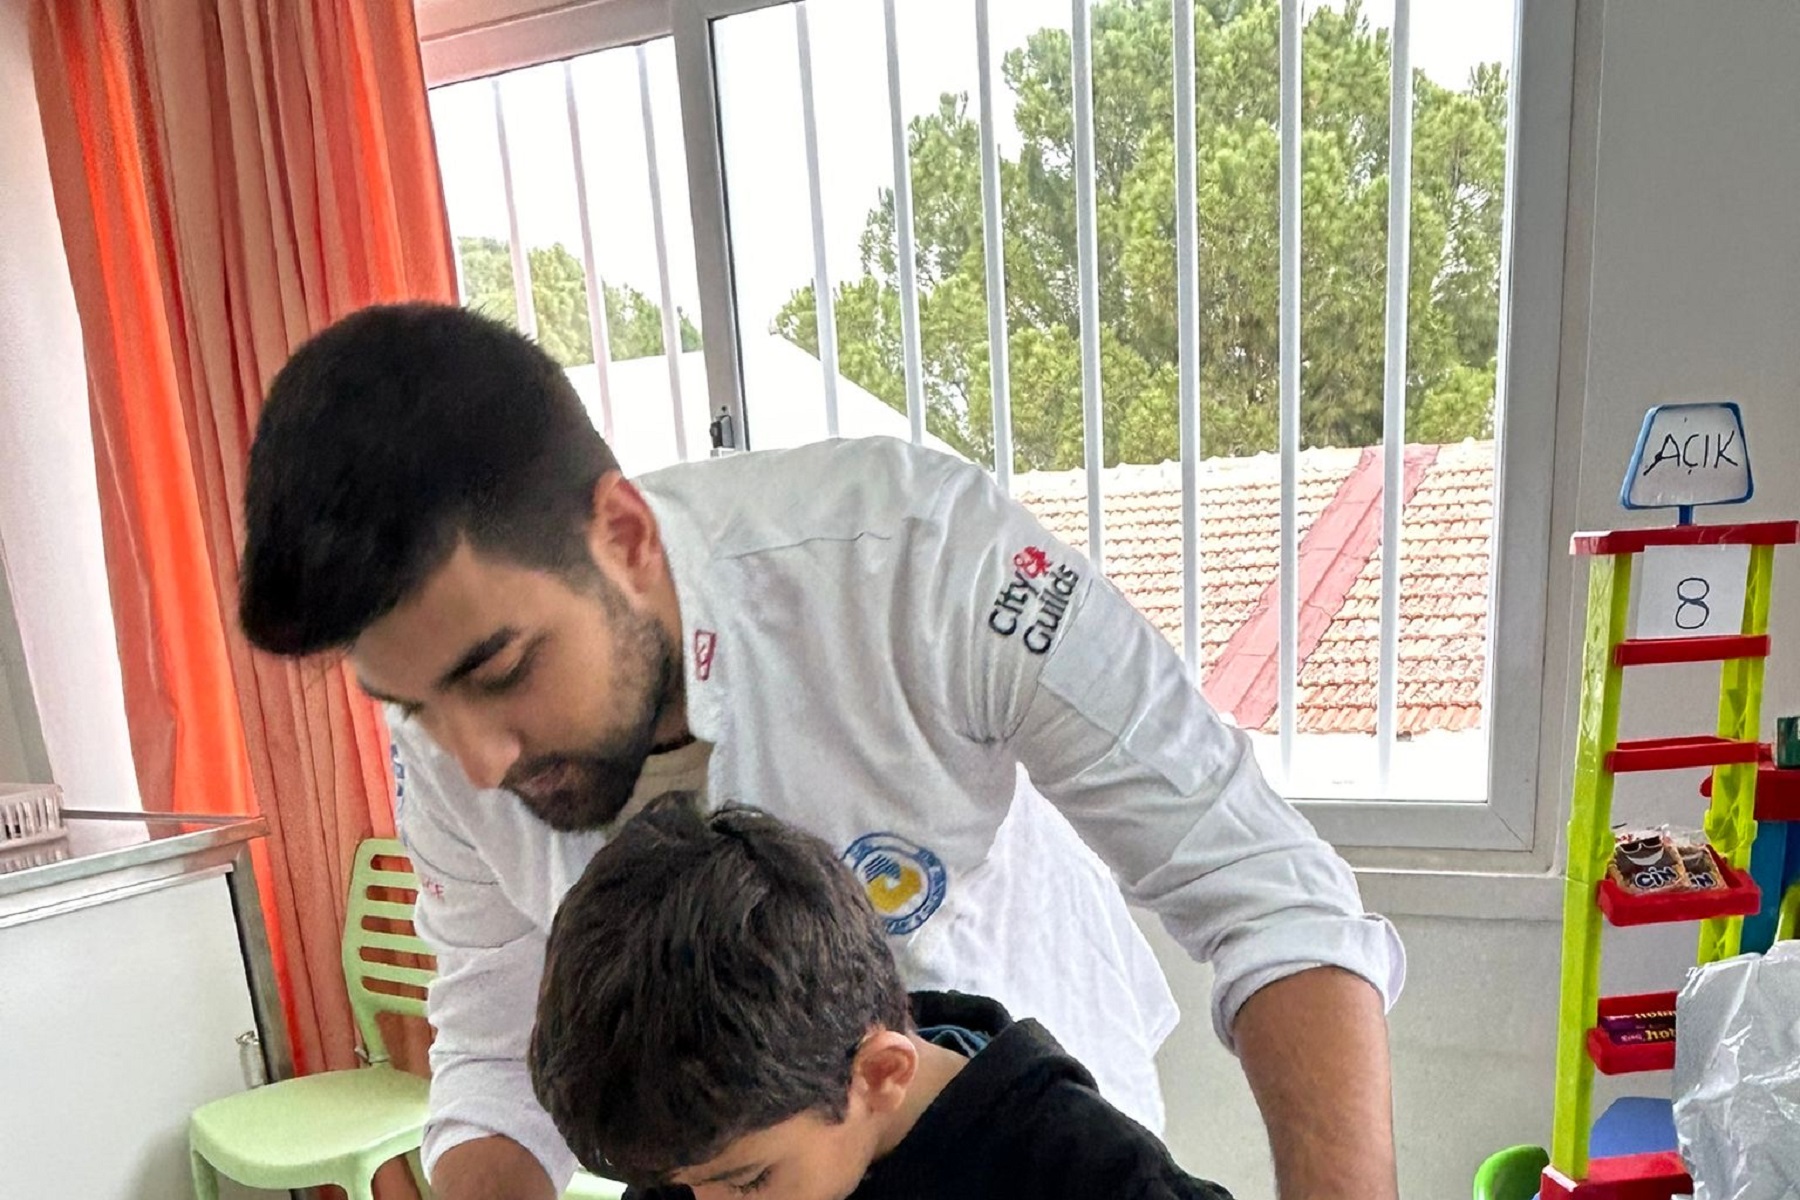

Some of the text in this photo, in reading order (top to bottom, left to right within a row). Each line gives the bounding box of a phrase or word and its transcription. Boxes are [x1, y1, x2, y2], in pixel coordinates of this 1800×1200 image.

[1643, 431, 1738, 475] AÇIK
[988, 570, 1039, 636] City
[1023, 564, 1079, 655] Guilds
[1675, 577, 1710, 630] 8
